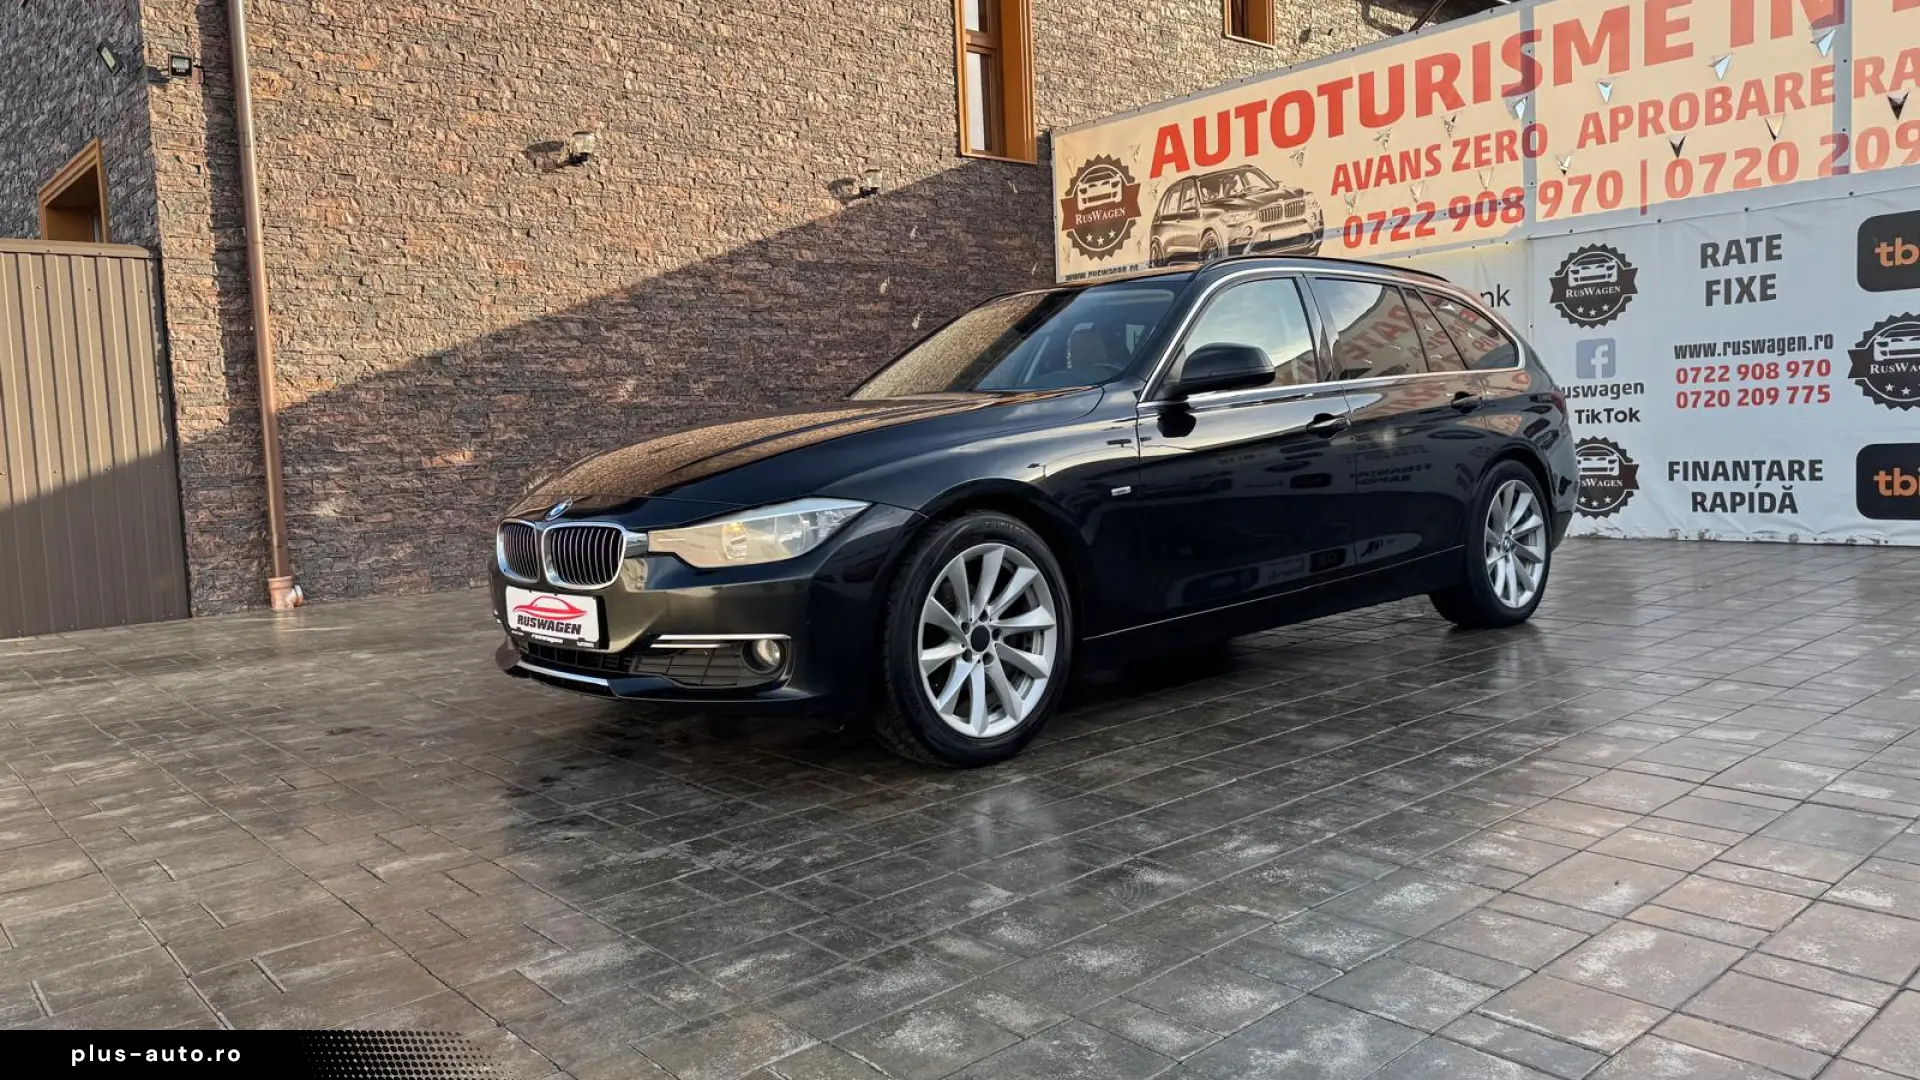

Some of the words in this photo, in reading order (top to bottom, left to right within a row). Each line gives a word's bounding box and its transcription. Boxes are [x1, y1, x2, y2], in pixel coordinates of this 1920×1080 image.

[1149, 0, 1694, 178] AUTOTURISME
[1331, 143, 1442, 196] AVANS
[1452, 123, 1548, 172] ZERO
[1577, 65, 1836, 149] APROBARE
[1853, 48, 1920, 99] RA
[1343, 204, 1436, 249] 0722
[1450, 186, 1526, 232] 908
[1538, 169, 1623, 219] 970
[1665, 141, 1799, 199] 0720
[1818, 119, 1920, 176] 209
[1075, 207, 1126, 225] RUSWAGEN
[1700, 234, 1783, 269] RATE
[1565, 285, 1621, 298] RUSWAGEN
[1705, 273, 1777, 307] FIXE
[1674, 334, 1834, 359] www.ruswagen.ro
[1676, 365, 1730, 384] 0722
[1736, 362, 1780, 381] 908
[1786, 359, 1831, 379] 970
[1870, 362, 1920, 374] RUSWA
[1676, 389, 1730, 409] 0720
[1737, 387, 1779, 406] 209
[1786, 384, 1831, 404] 775
[1575, 407, 1641, 424] TikTok
[1580, 477, 1624, 487] SWAGEN
[1691, 485, 1799, 514] RAPIDĂ
[517, 615, 582, 635] RUSWAGEN
